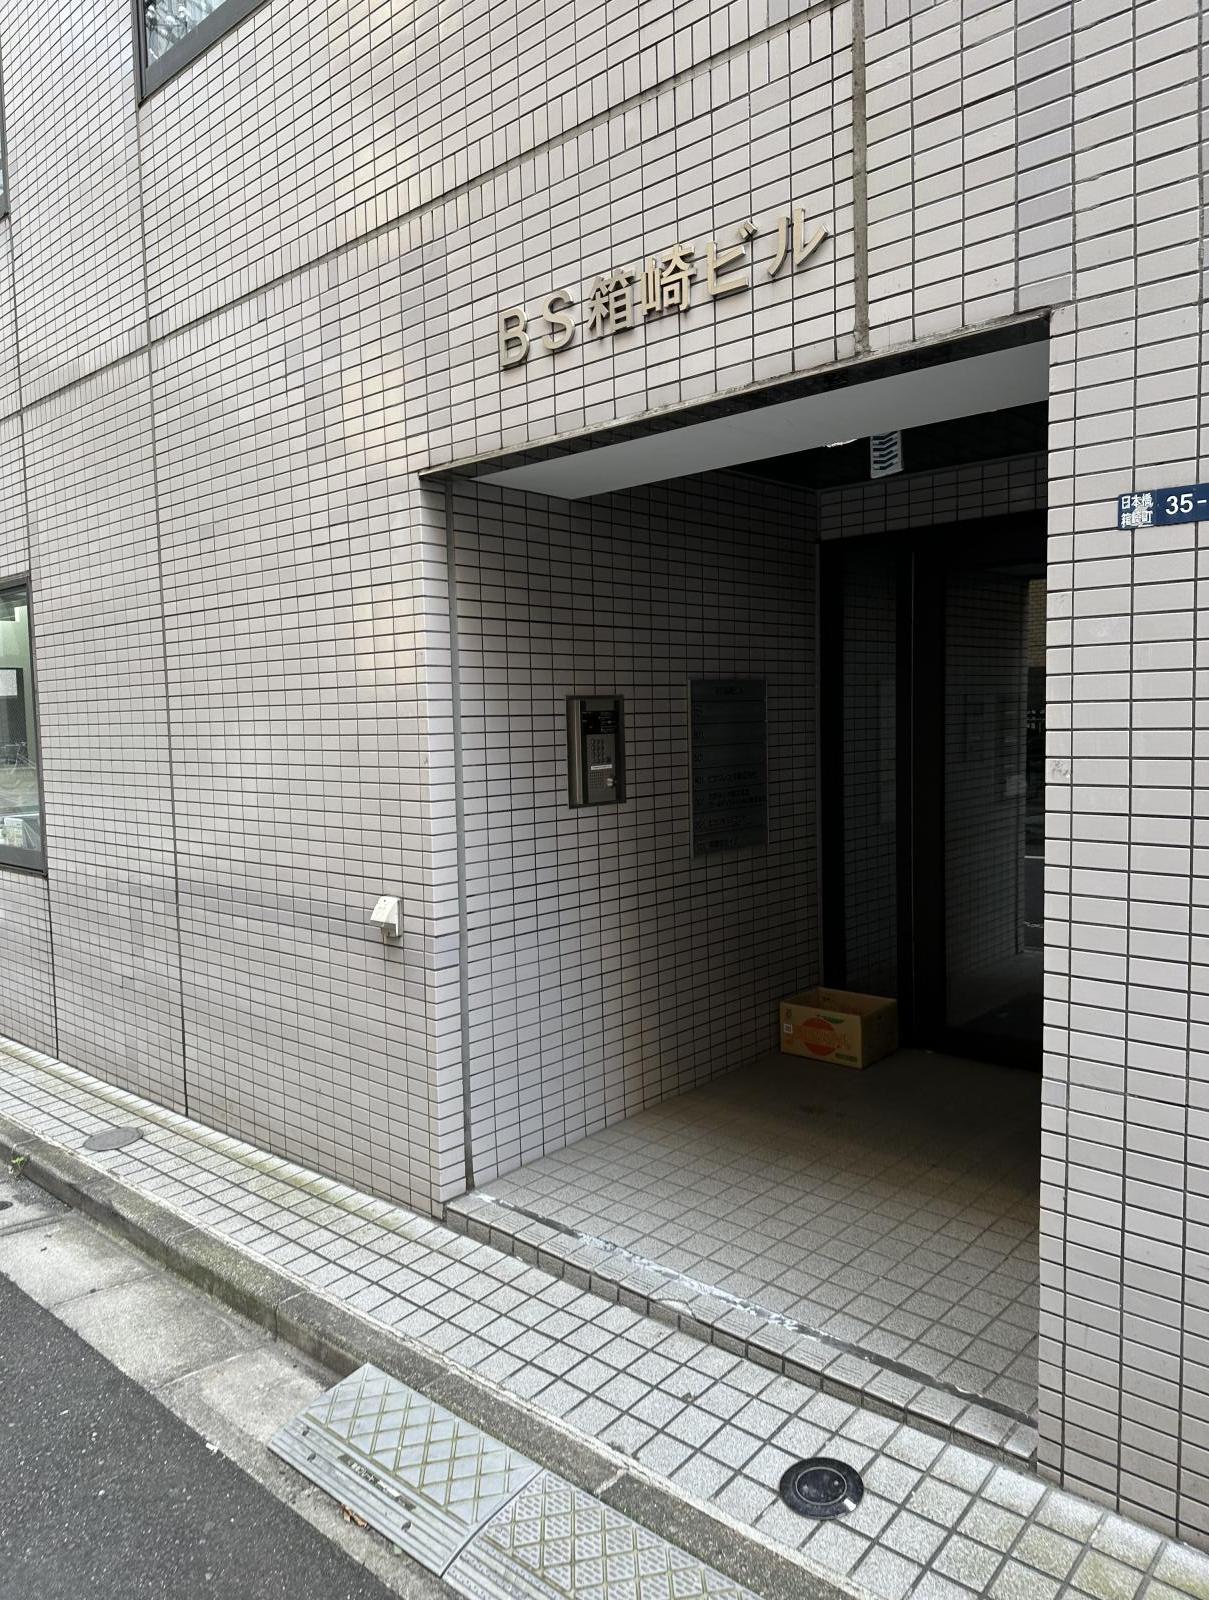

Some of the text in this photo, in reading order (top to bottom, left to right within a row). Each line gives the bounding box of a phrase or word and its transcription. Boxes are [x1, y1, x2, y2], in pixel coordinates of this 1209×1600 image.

[499, 208, 829, 368] BS箱崎ビル
[1121, 492, 1154, 509] 日本橋
